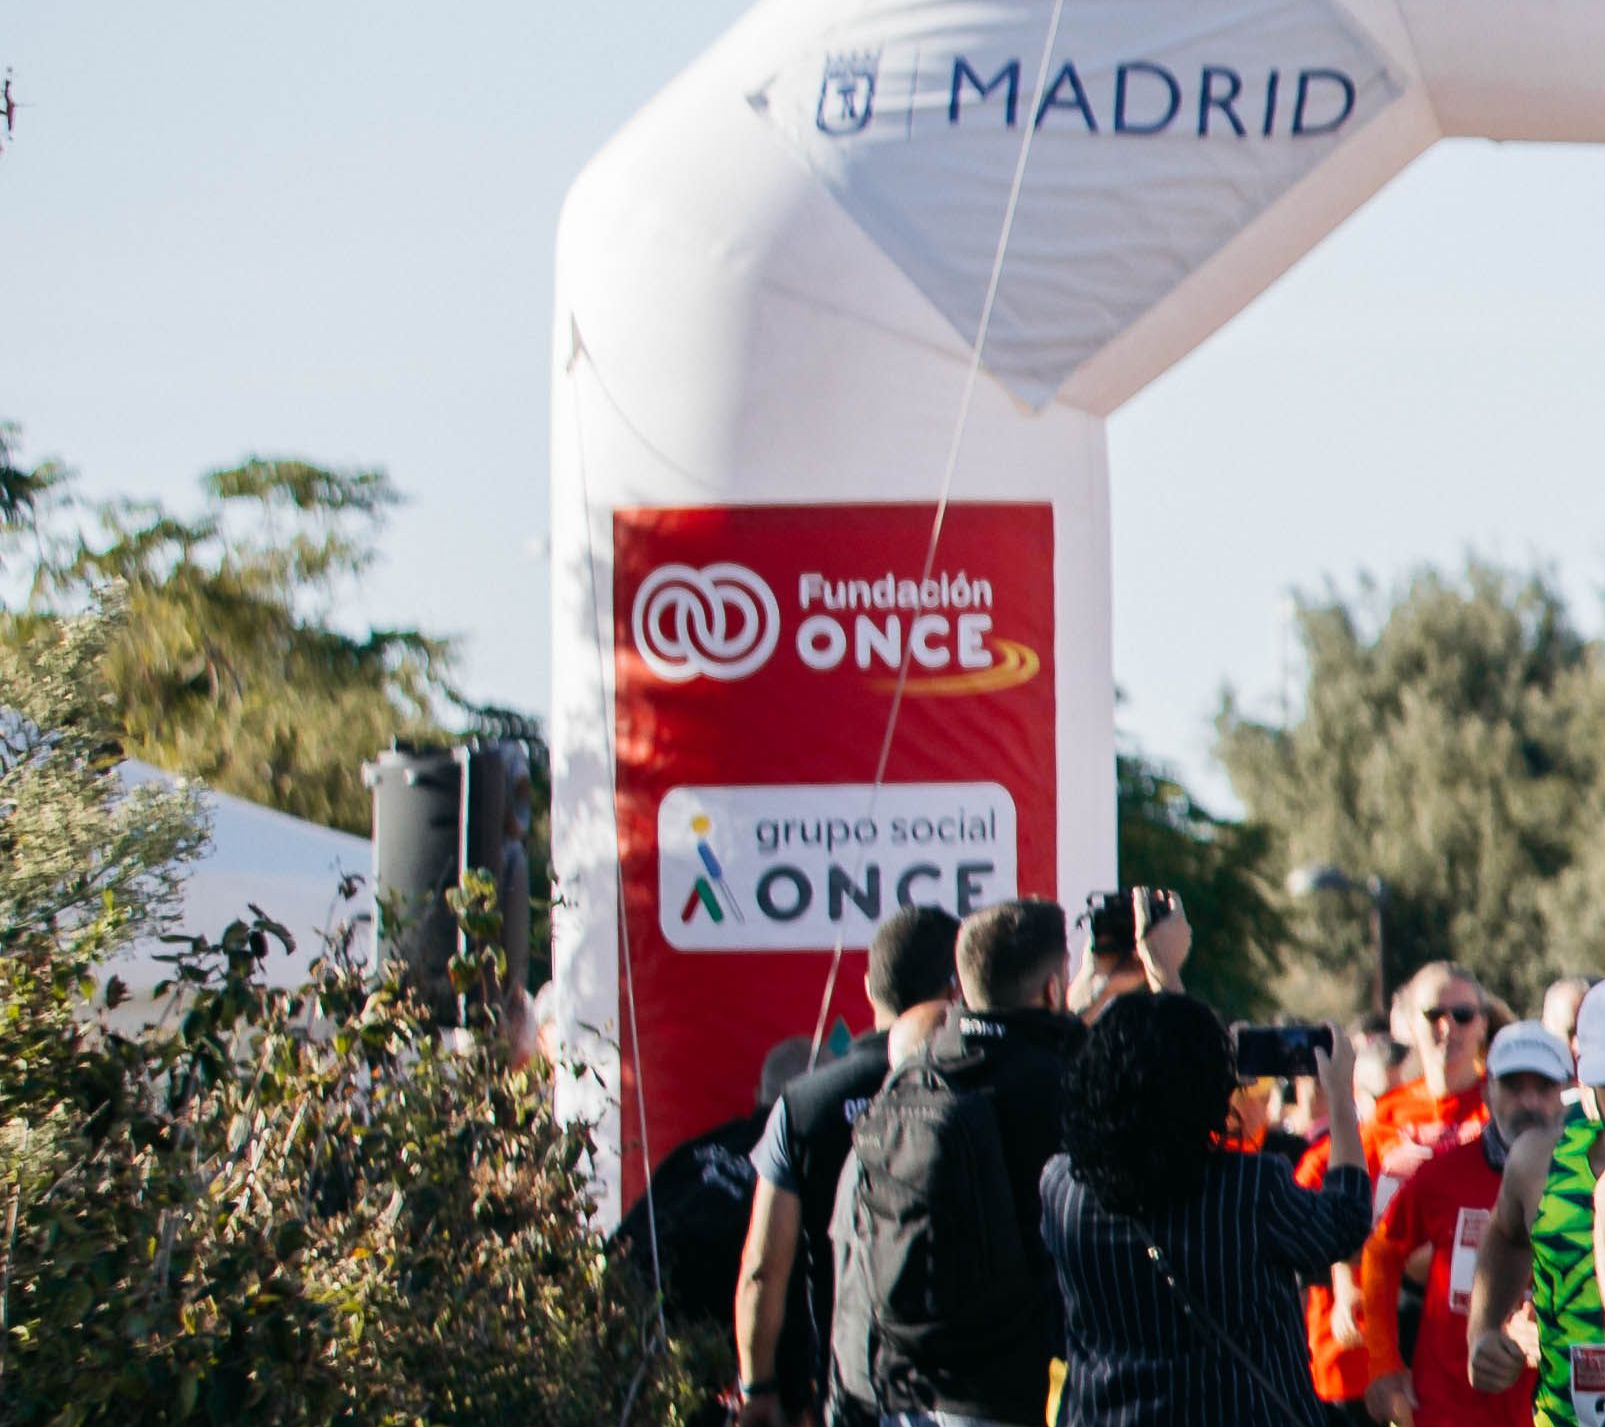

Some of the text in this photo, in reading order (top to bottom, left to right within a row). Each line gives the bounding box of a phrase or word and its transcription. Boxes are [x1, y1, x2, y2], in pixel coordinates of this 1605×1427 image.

[948, 56, 1356, 139] MADRID
[800, 572, 994, 609] Fundación
[797, 612, 994, 670] ONCE
[755, 808, 997, 855] grupo social
[755, 862, 997, 925] ONCE
